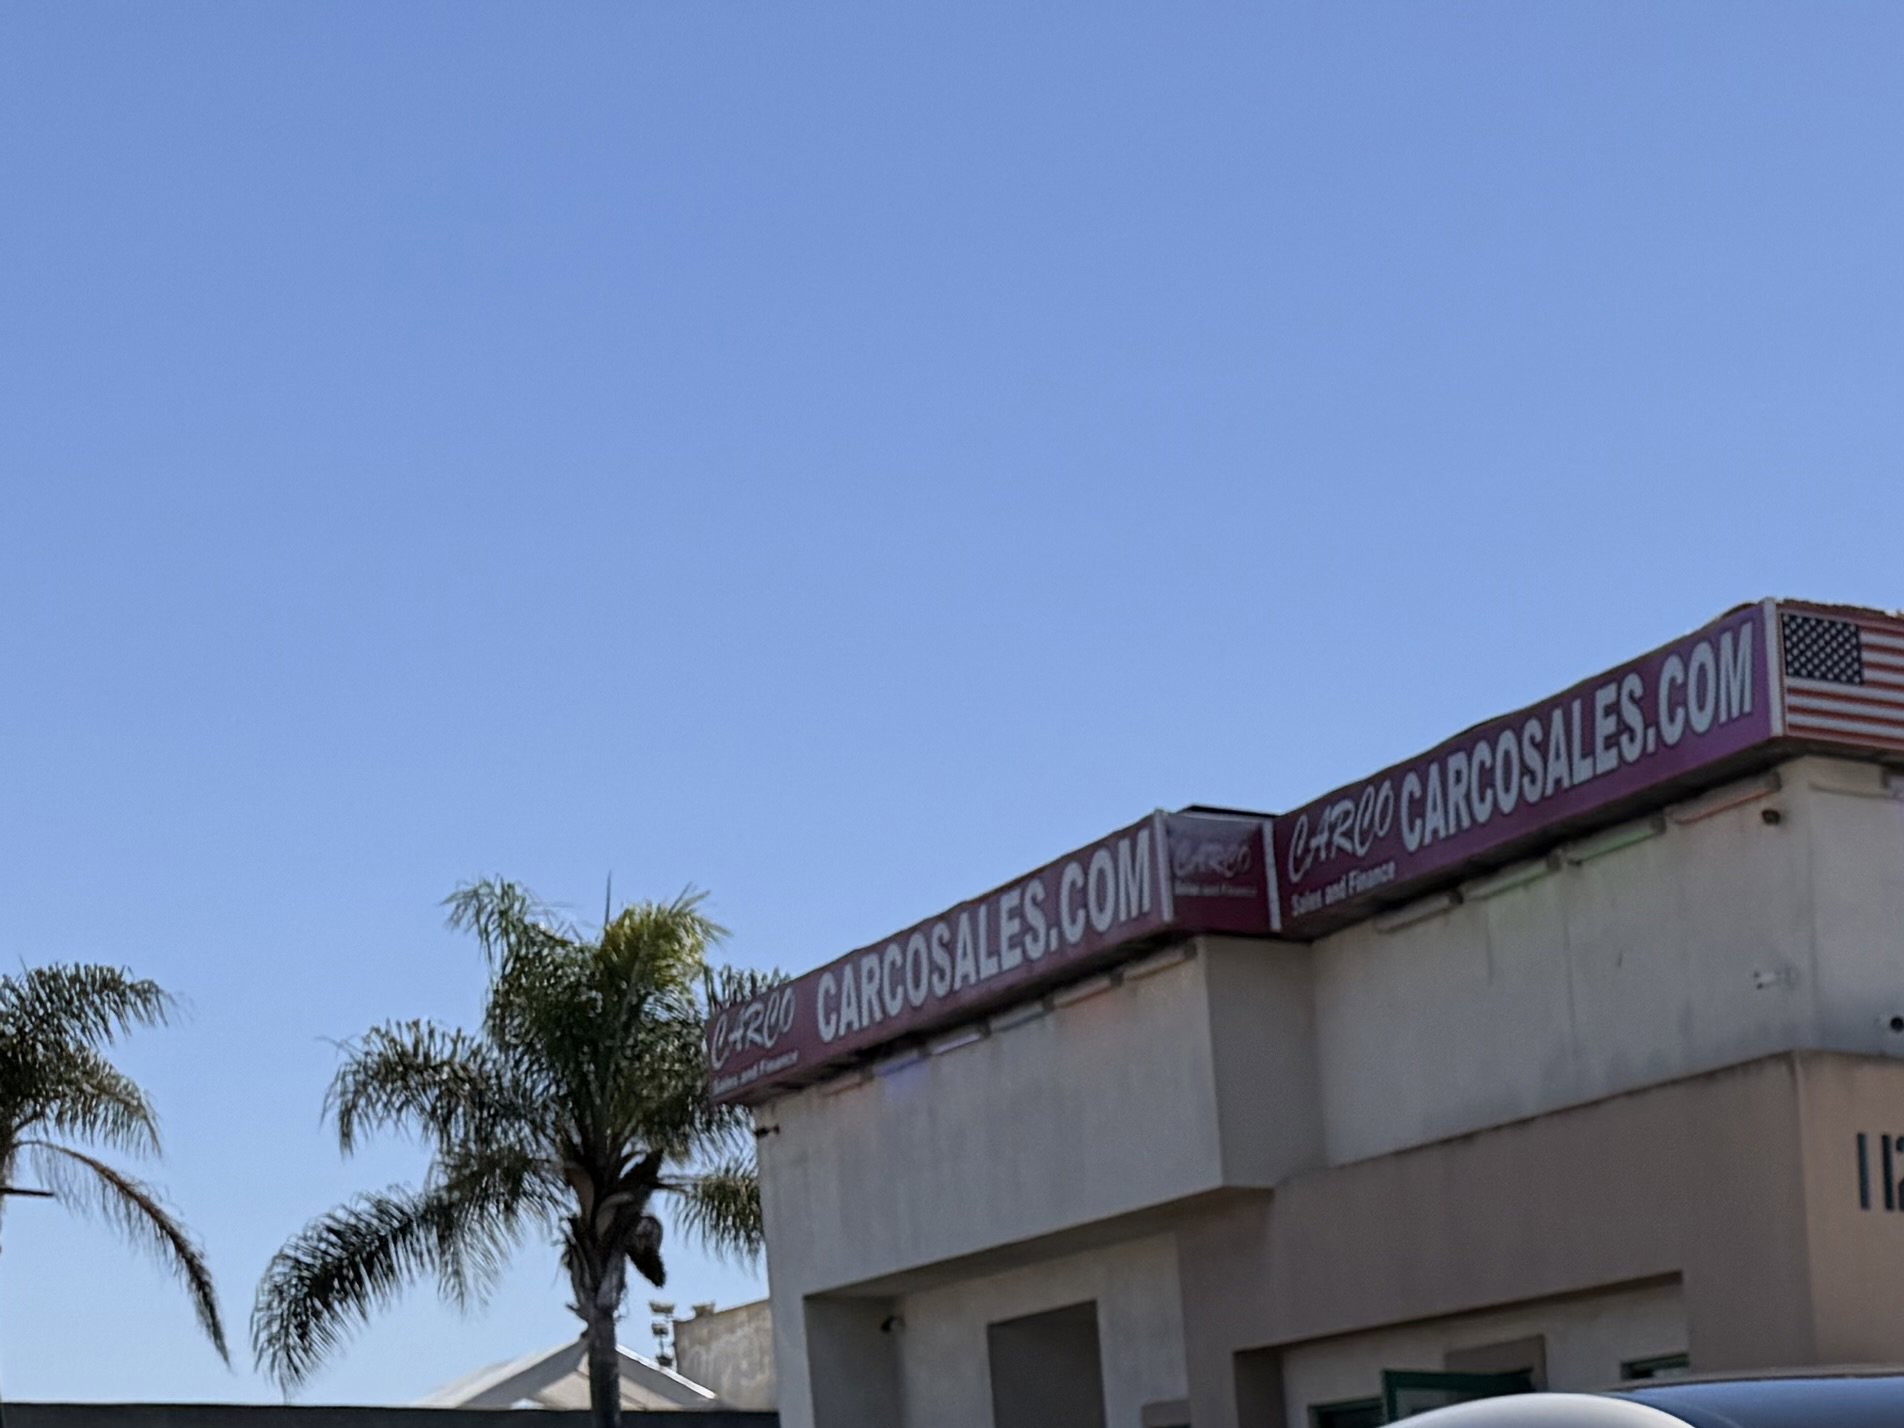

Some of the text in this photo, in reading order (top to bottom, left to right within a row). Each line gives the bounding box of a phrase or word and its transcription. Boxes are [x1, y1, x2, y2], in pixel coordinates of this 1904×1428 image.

[1400, 621, 1754, 853] CARCOSALES.COM
[1289, 779, 1396, 883] CARCO
[816, 828, 1152, 1043] CARCOSALES.COM
[710, 987, 796, 1071] CARCO
